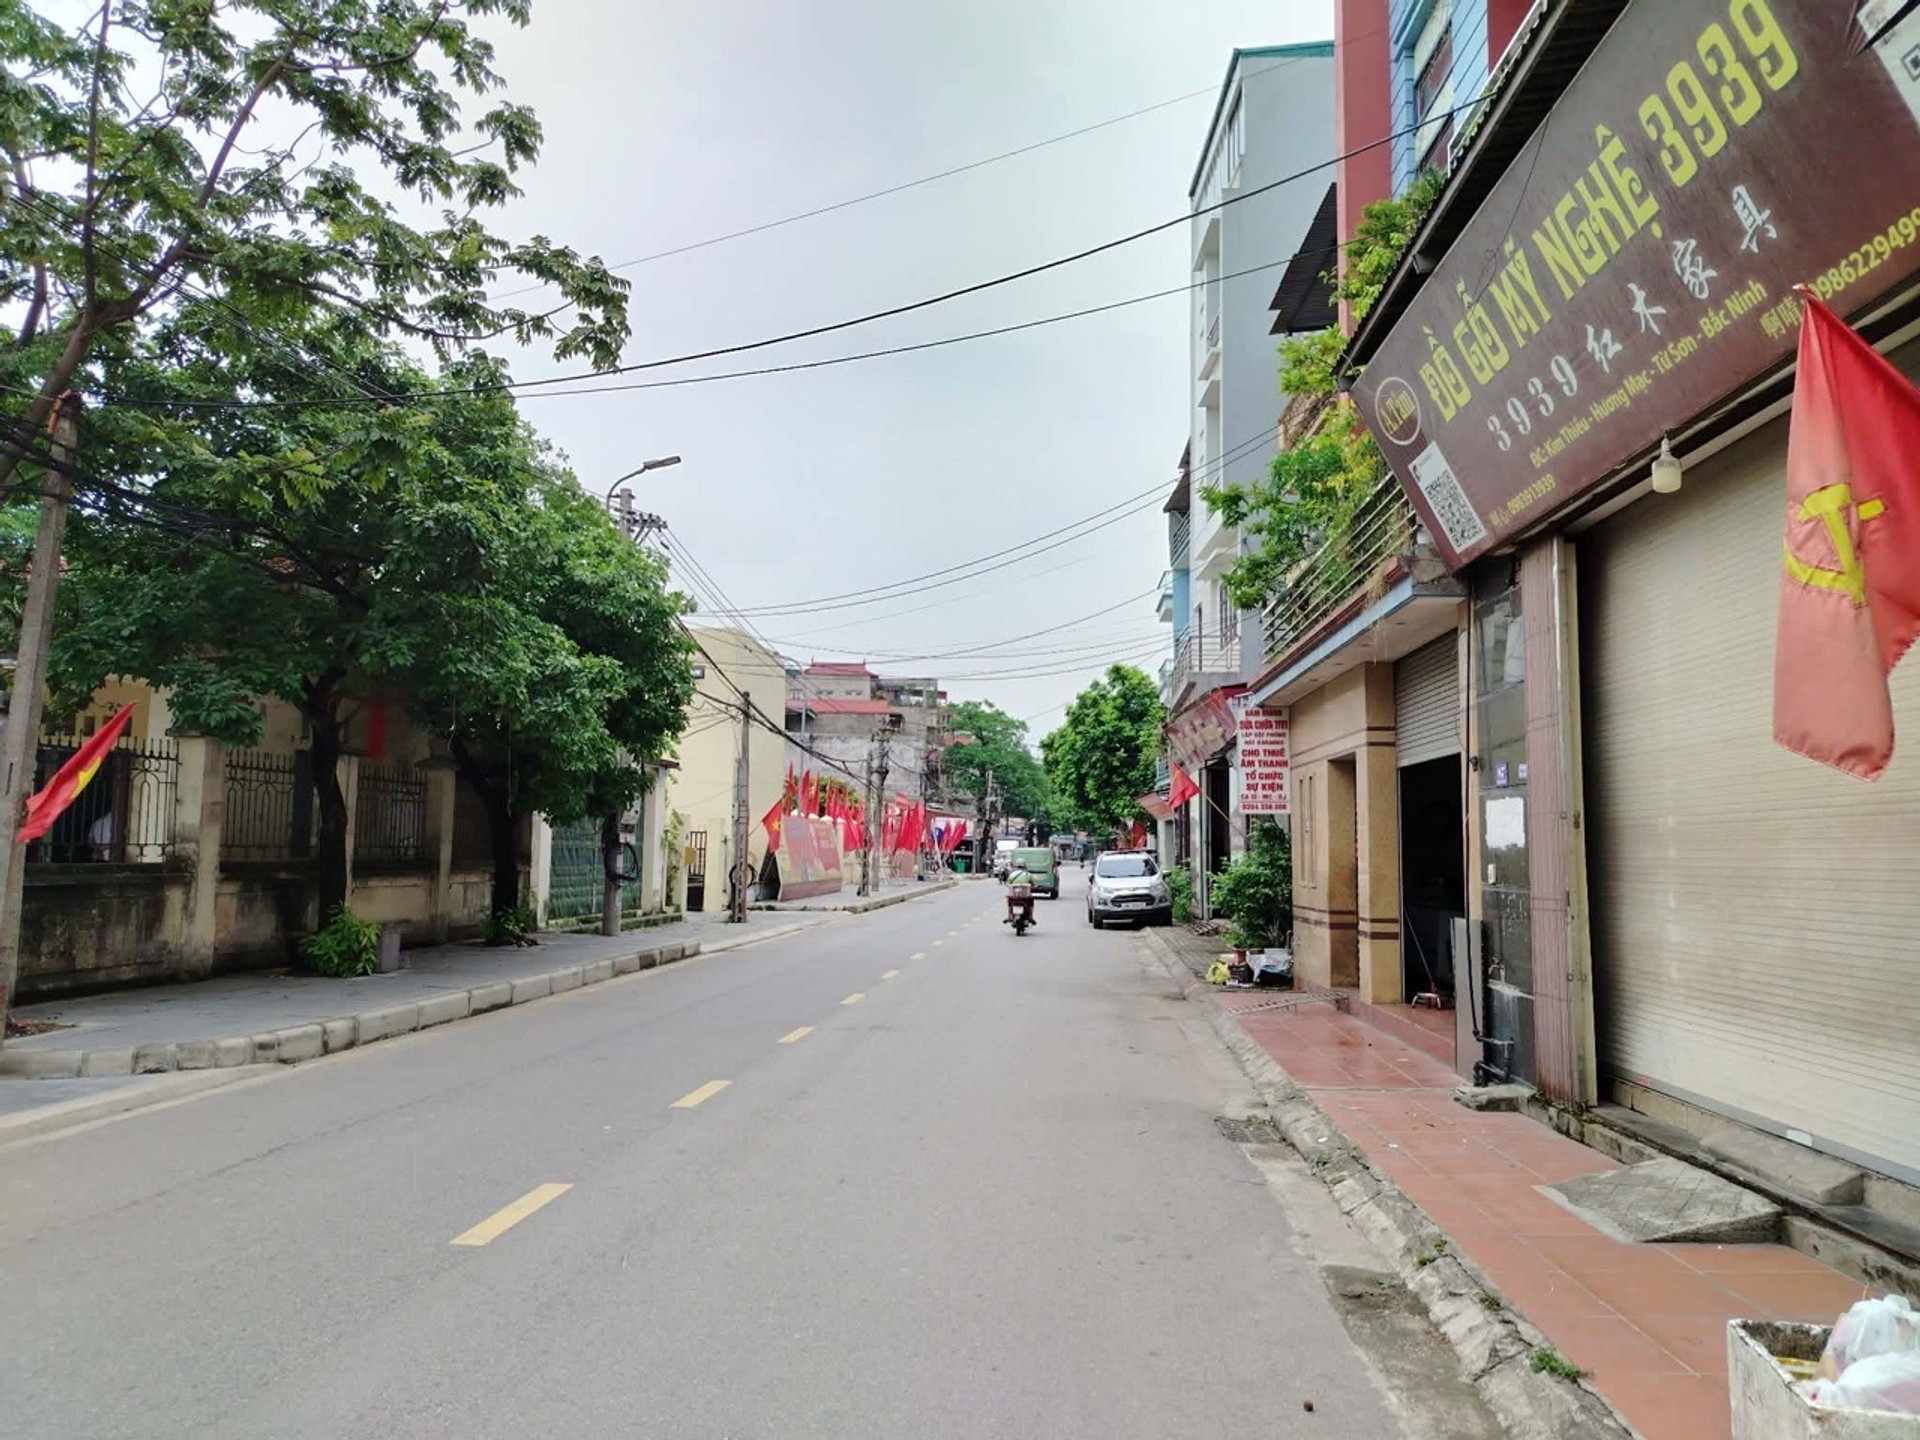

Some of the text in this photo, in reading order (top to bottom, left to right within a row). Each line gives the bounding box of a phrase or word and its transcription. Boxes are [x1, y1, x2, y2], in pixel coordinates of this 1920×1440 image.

[1419, 0, 1798, 423] ĐỒ GỖ MỸ NGHỆ 3939
[1623, 370, 1651, 398] Mạc
[1667, 336, 1698, 364] Sơn
[1699, 307, 1731, 339] Bắc
[1725, 279, 1768, 319] Ninh
[1241, 747, 1285, 757] CHO THUÊ
[1240, 758, 1288, 768] ÂM THANH
[1258, 771, 1284, 780] CHỨC
[1246, 781, 1284, 792] SỰ KIỆN
